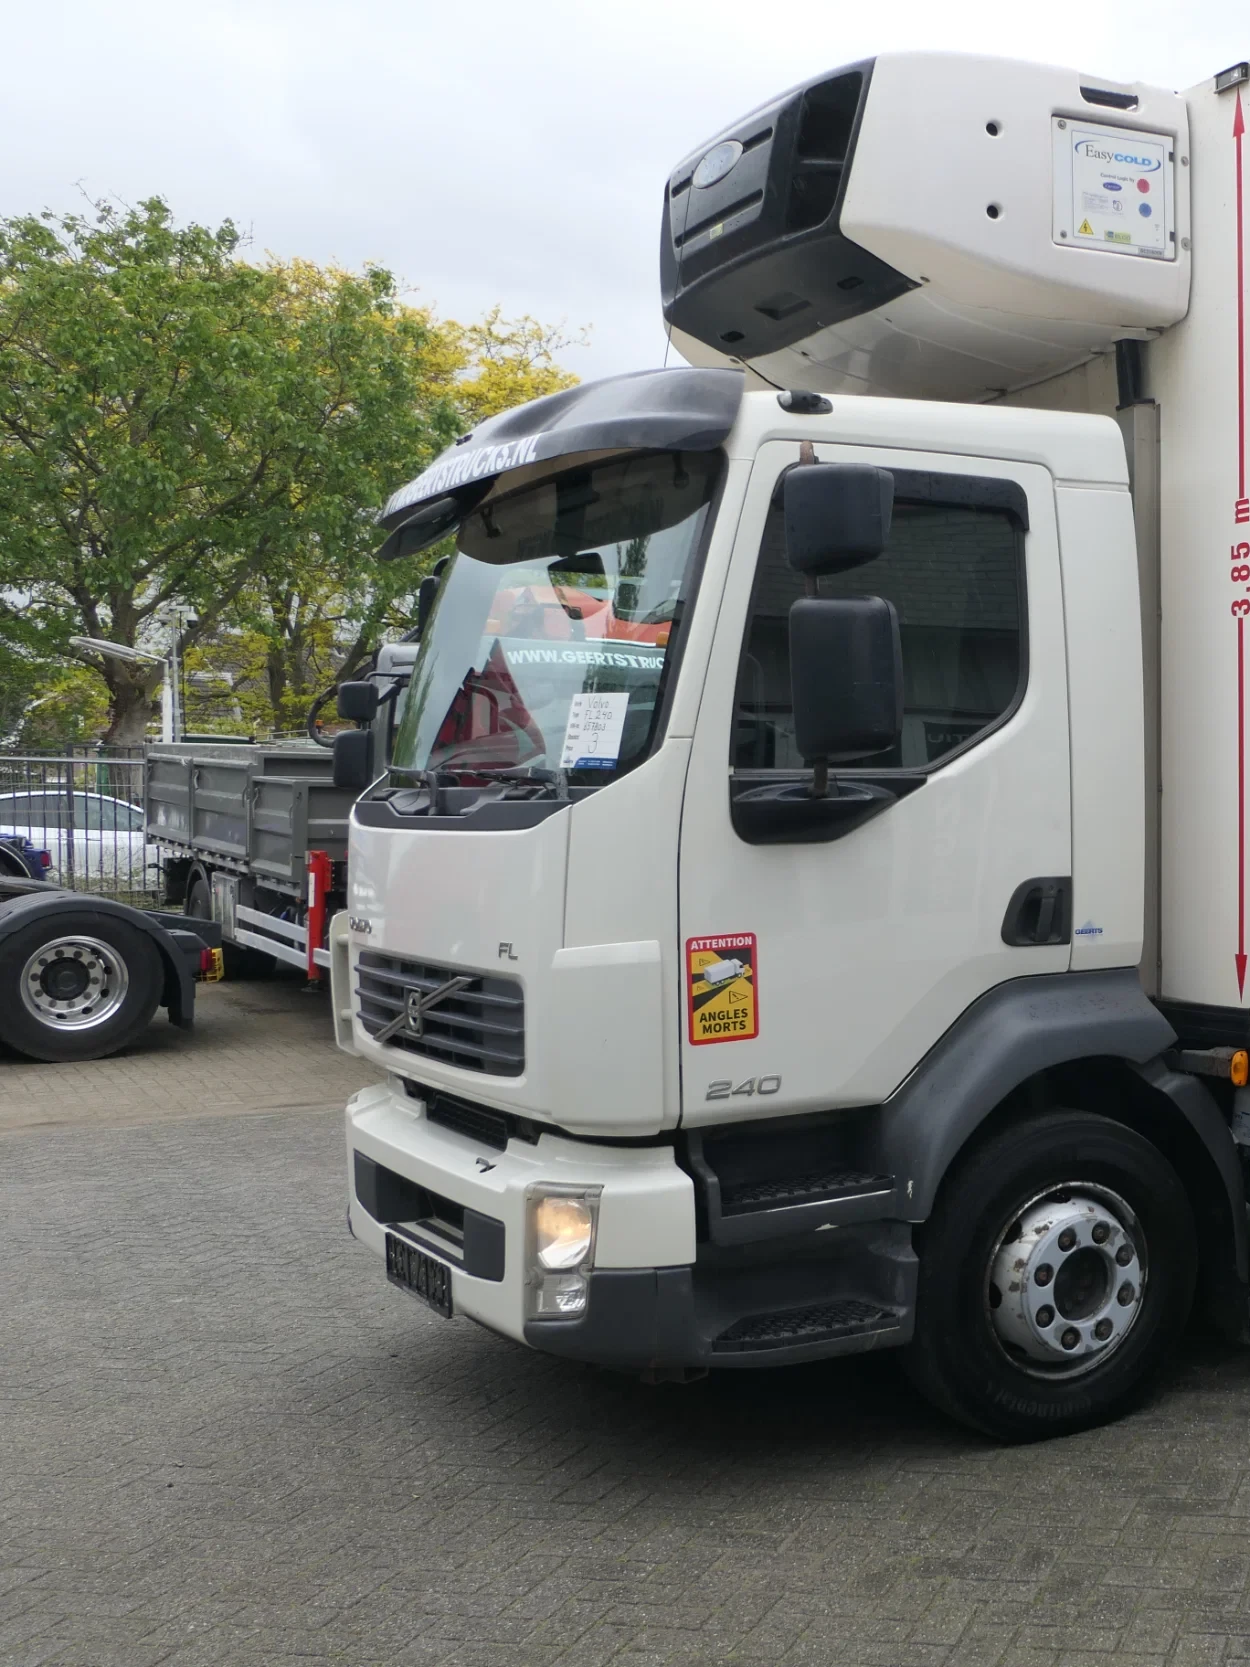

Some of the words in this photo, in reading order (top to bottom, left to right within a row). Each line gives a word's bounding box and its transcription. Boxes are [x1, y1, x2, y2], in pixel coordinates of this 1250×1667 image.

[1085, 144, 1152, 167] EasyCOLD
[1234, 498, 1250, 525] m
[588, 695, 610, 709] Volvo
[498, 941, 519, 961] FL
[690, 936, 753, 951] ATTENTION
[699, 1008, 749, 1023] ANGLES
[702, 1020, 747, 1035] MORTS
[705, 1073, 782, 1101] 240
